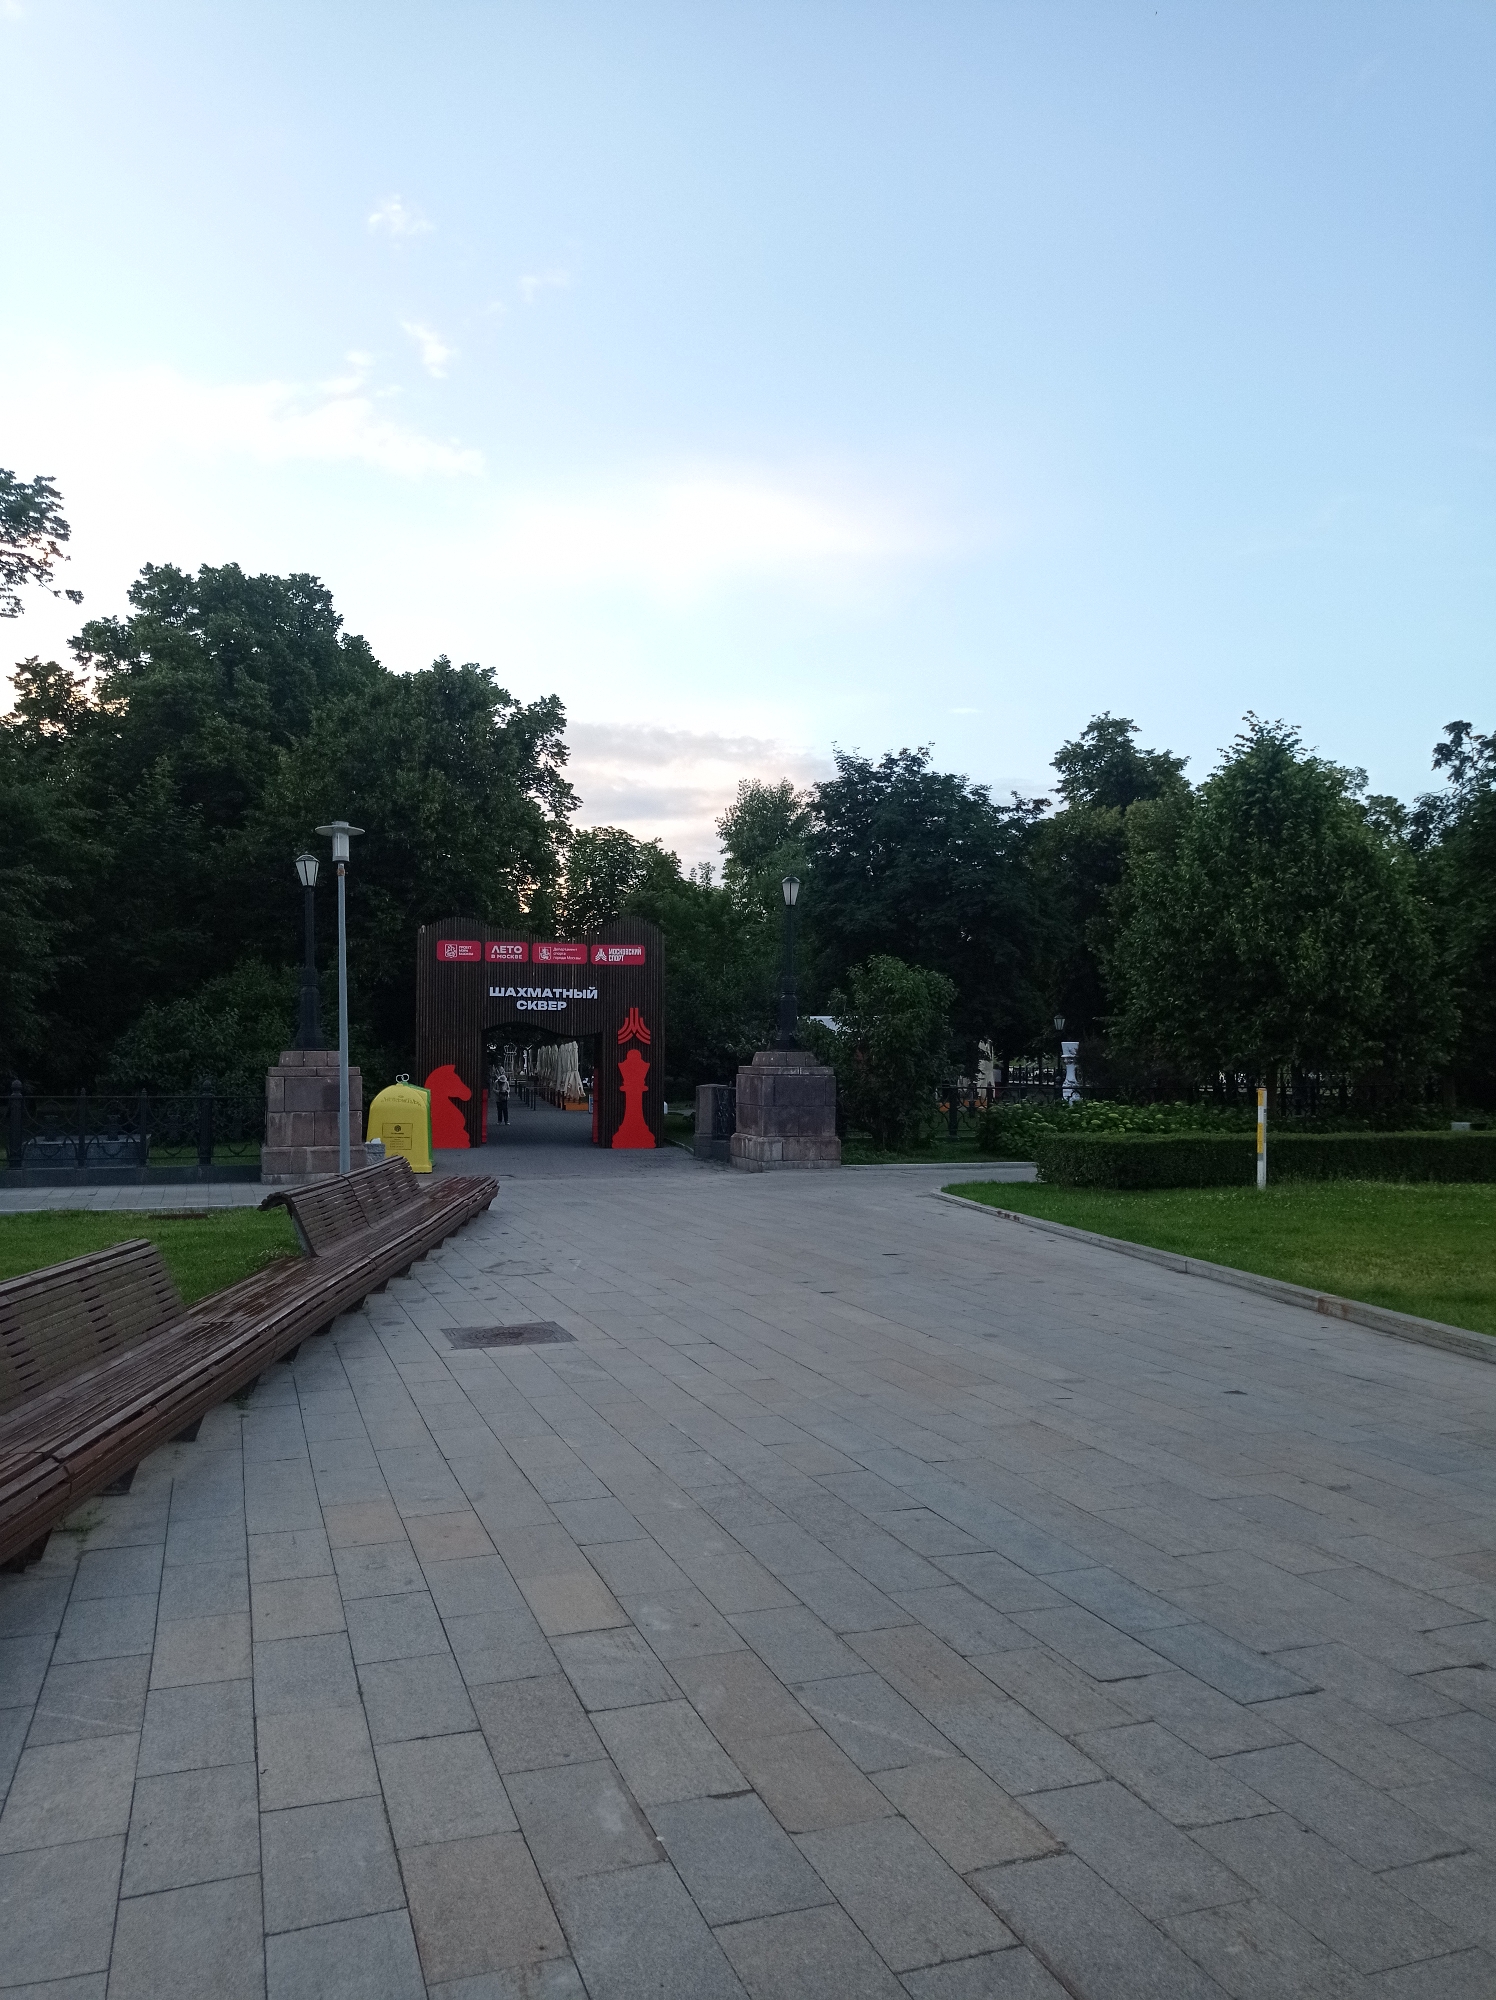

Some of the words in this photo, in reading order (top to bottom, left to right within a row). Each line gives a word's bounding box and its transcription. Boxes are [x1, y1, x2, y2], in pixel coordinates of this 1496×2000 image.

[491, 945, 523, 953] ЛЕТО
[609, 947, 642, 955] МОСКОВСКИЙ
[489, 986, 598, 999] ШАХМАТНЫЙ
[516, 1000, 567, 1011] СКВЕР
